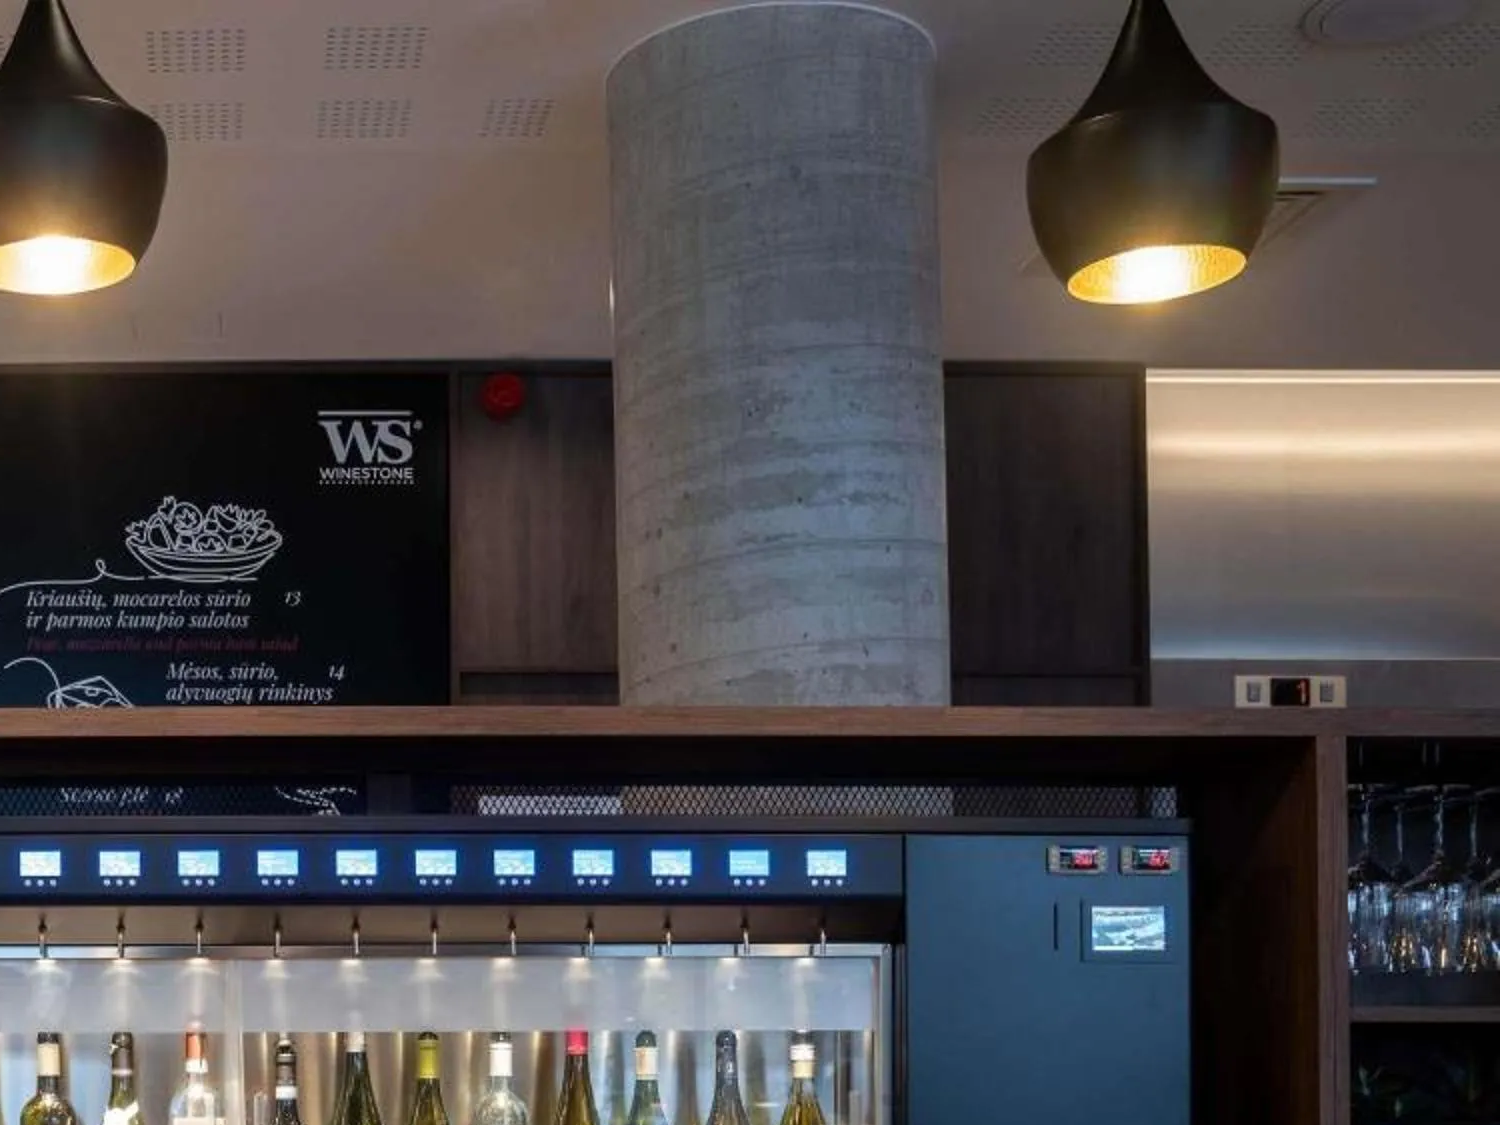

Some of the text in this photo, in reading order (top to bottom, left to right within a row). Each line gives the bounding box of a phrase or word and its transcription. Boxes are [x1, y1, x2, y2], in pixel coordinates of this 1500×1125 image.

[319, 467, 414, 480] WINESTONE
[113, 588, 201, 608] mocarelos
[26, 610, 249, 632] ir parmos kumpio salotos
[328, 664, 345, 681] 14
[258, 683, 334, 705] rinkinys
